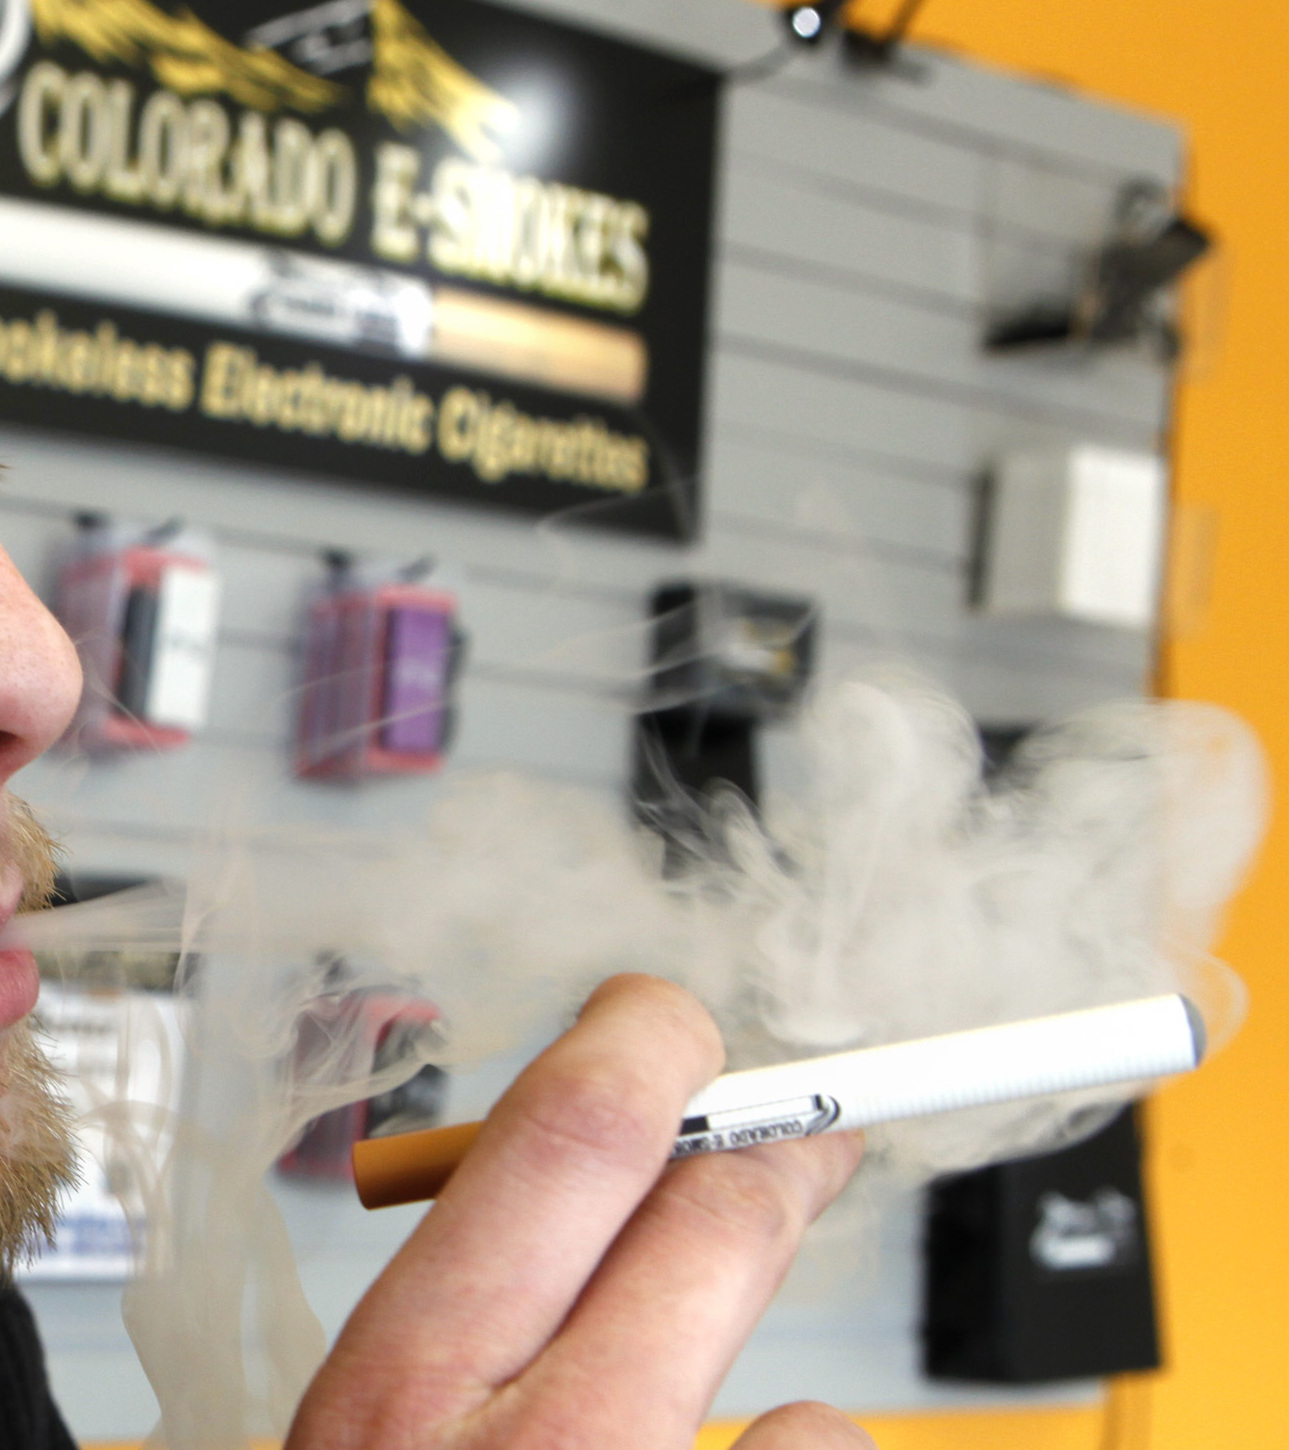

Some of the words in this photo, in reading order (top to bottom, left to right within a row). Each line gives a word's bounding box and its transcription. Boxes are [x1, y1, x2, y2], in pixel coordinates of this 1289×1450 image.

[17, 61, 356, 248] COLORADO
[372, 141, 649, 316] E-SMOKES
[200, 341, 434, 455] Electronic
[437, 385, 649, 494] Cigarettes
[673, 1135, 725, 1154] E-SMOK
[729, 1119, 804, 1147] COLORADO
